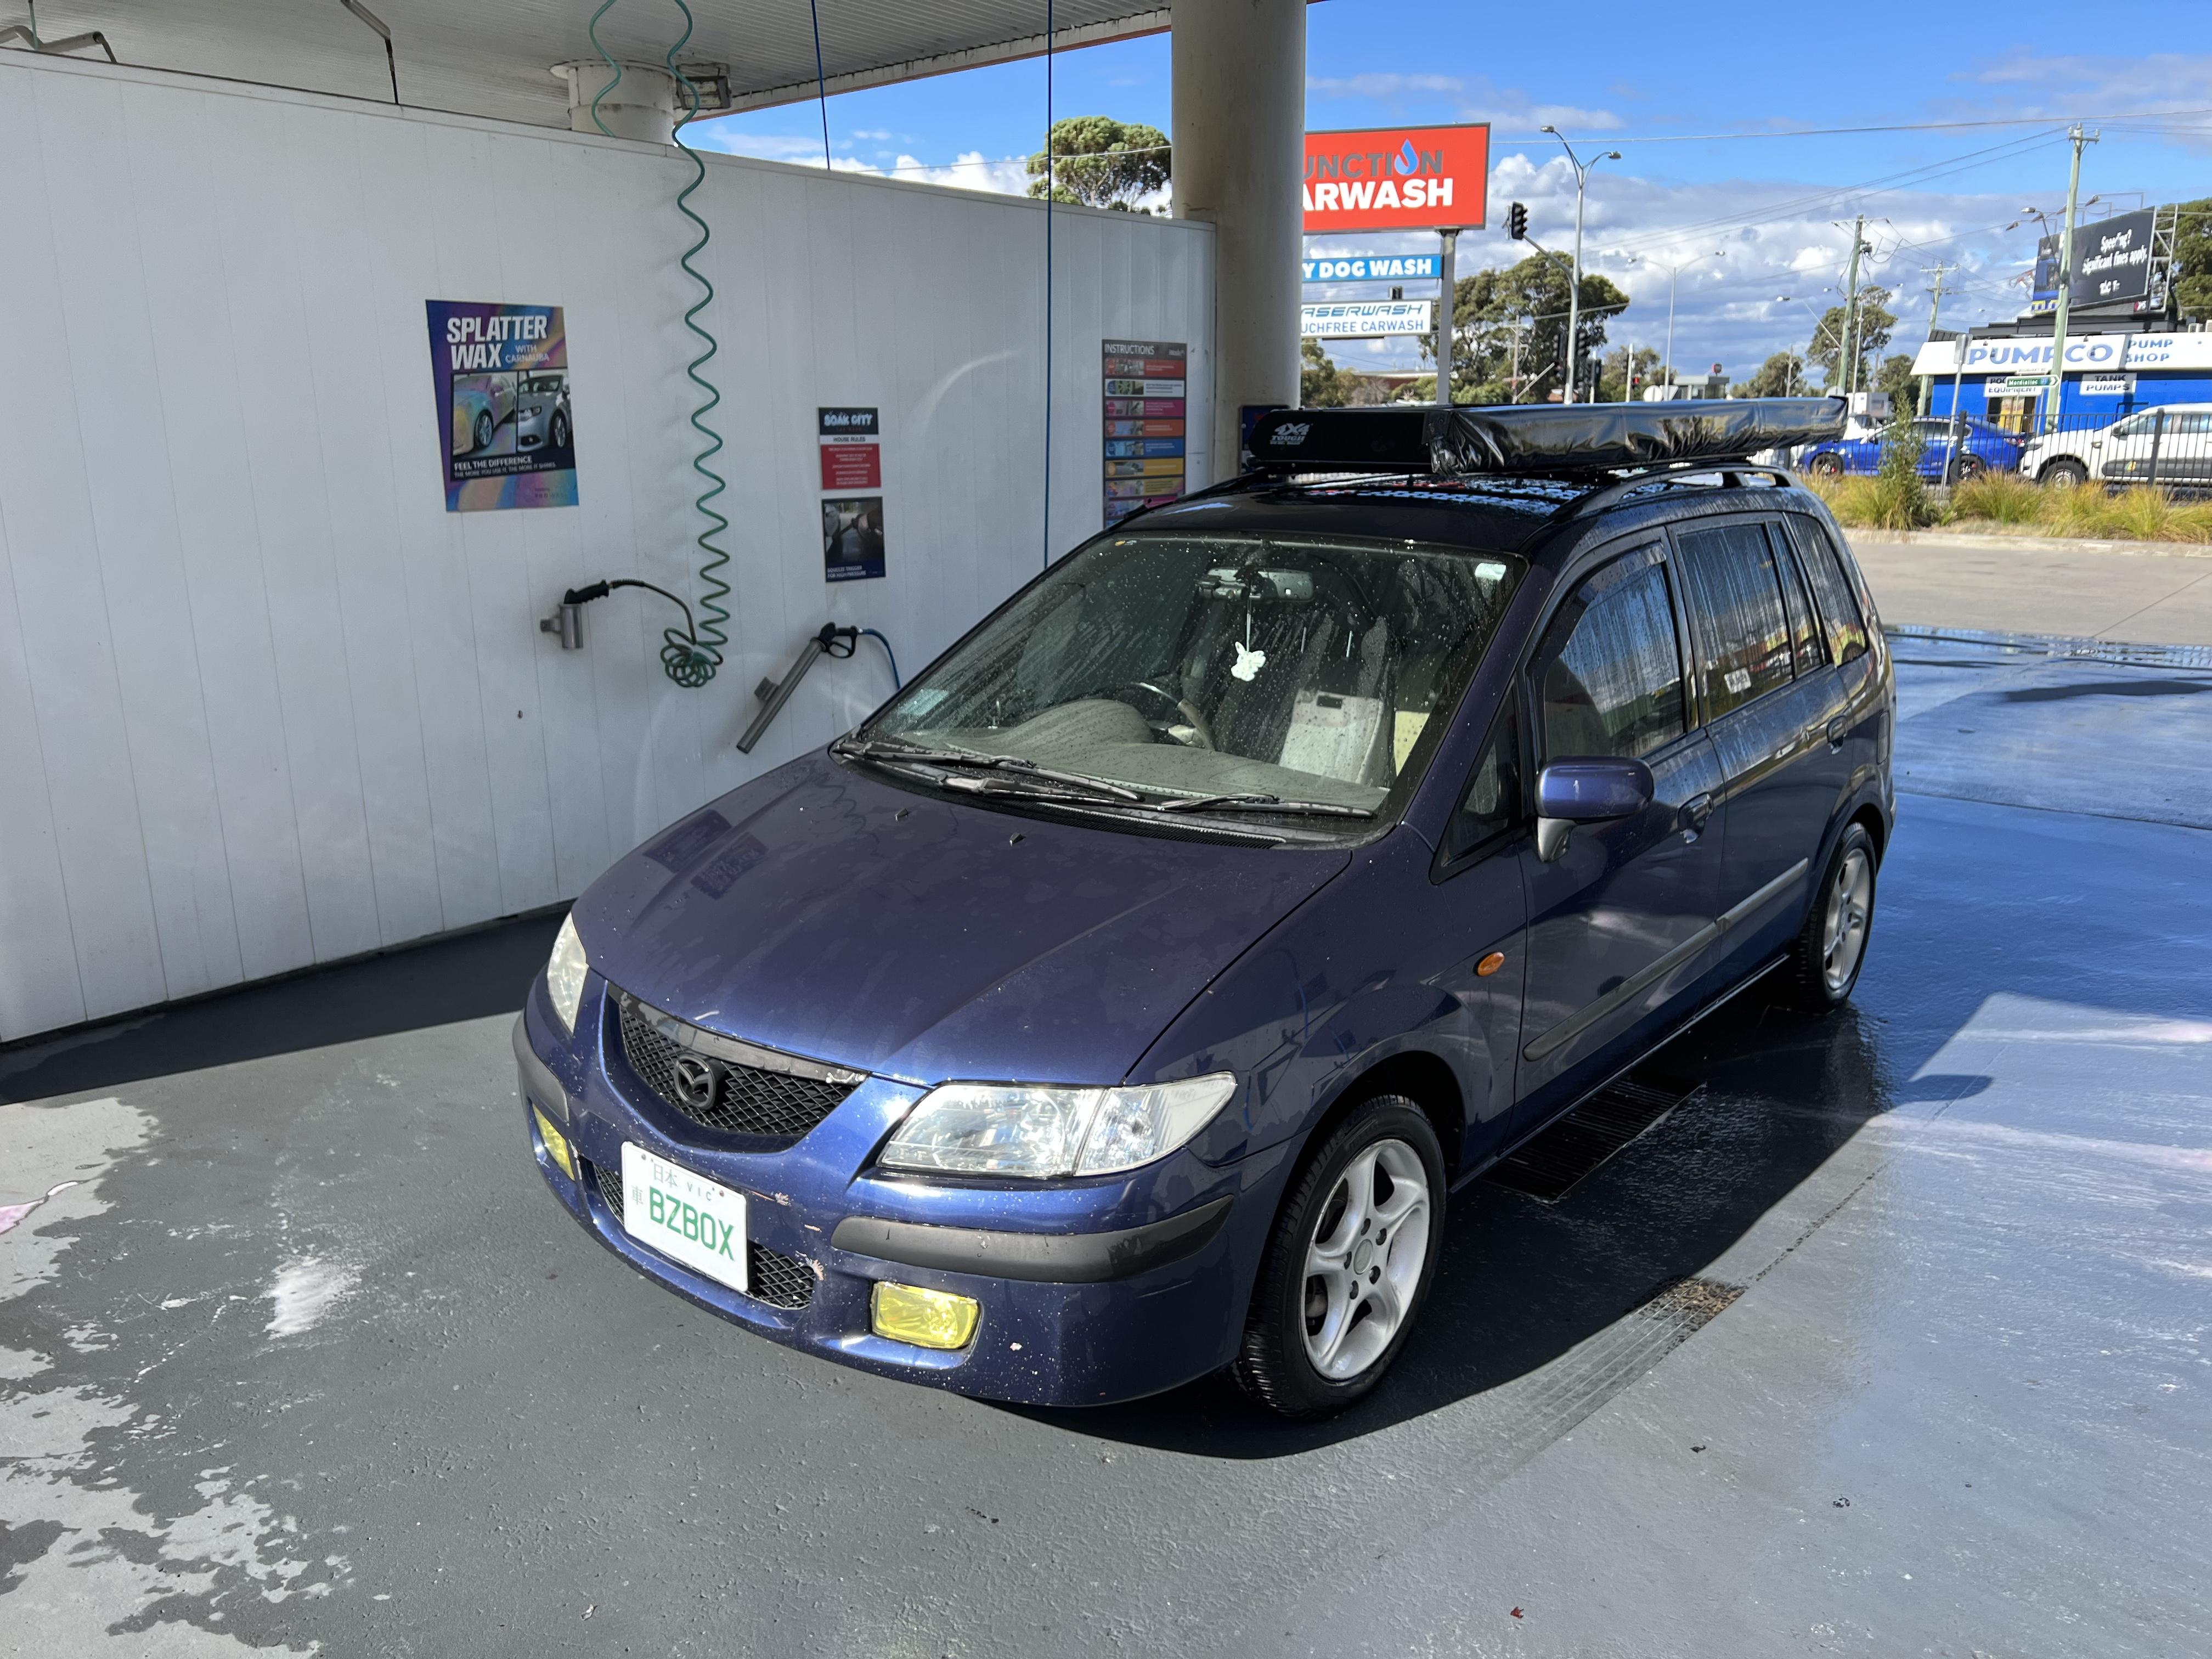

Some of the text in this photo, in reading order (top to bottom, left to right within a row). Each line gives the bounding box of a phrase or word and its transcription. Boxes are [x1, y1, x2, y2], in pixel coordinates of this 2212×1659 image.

[1304, 139, 1443, 179] UNCTION
[1302, 178, 1453, 211] ARWASH
[2113, 251, 2129, 266] fines
[1302, 258, 1432, 278] Y DOG WASH
[1301, 304, 1423, 318] ASERWASH
[447, 315, 548, 344] SPLATTER
[1301, 320, 1424, 334] UCHFREE CARWASH
[515, 345, 537, 353] WITH
[1104, 343, 1155, 355] INSTRUCTIONS
[2127, 338, 2173, 349] PUMP
[450, 343, 502, 370] WAX
[505, 351, 550, 363] CARNAUBA
[1967, 343, 2113, 365] PUMPCO
[2125, 353, 2170, 363] SHOP
[2086, 383, 2130, 392] PUMPS
[851, 413, 873, 426] CITY
[454, 455, 532, 471] FEEL THE DIFFERENCE
[653, 1163, 678, 1188] 日本
[631, 1186, 644, 1206] 車
[687, 1182, 712, 1201] VIC
